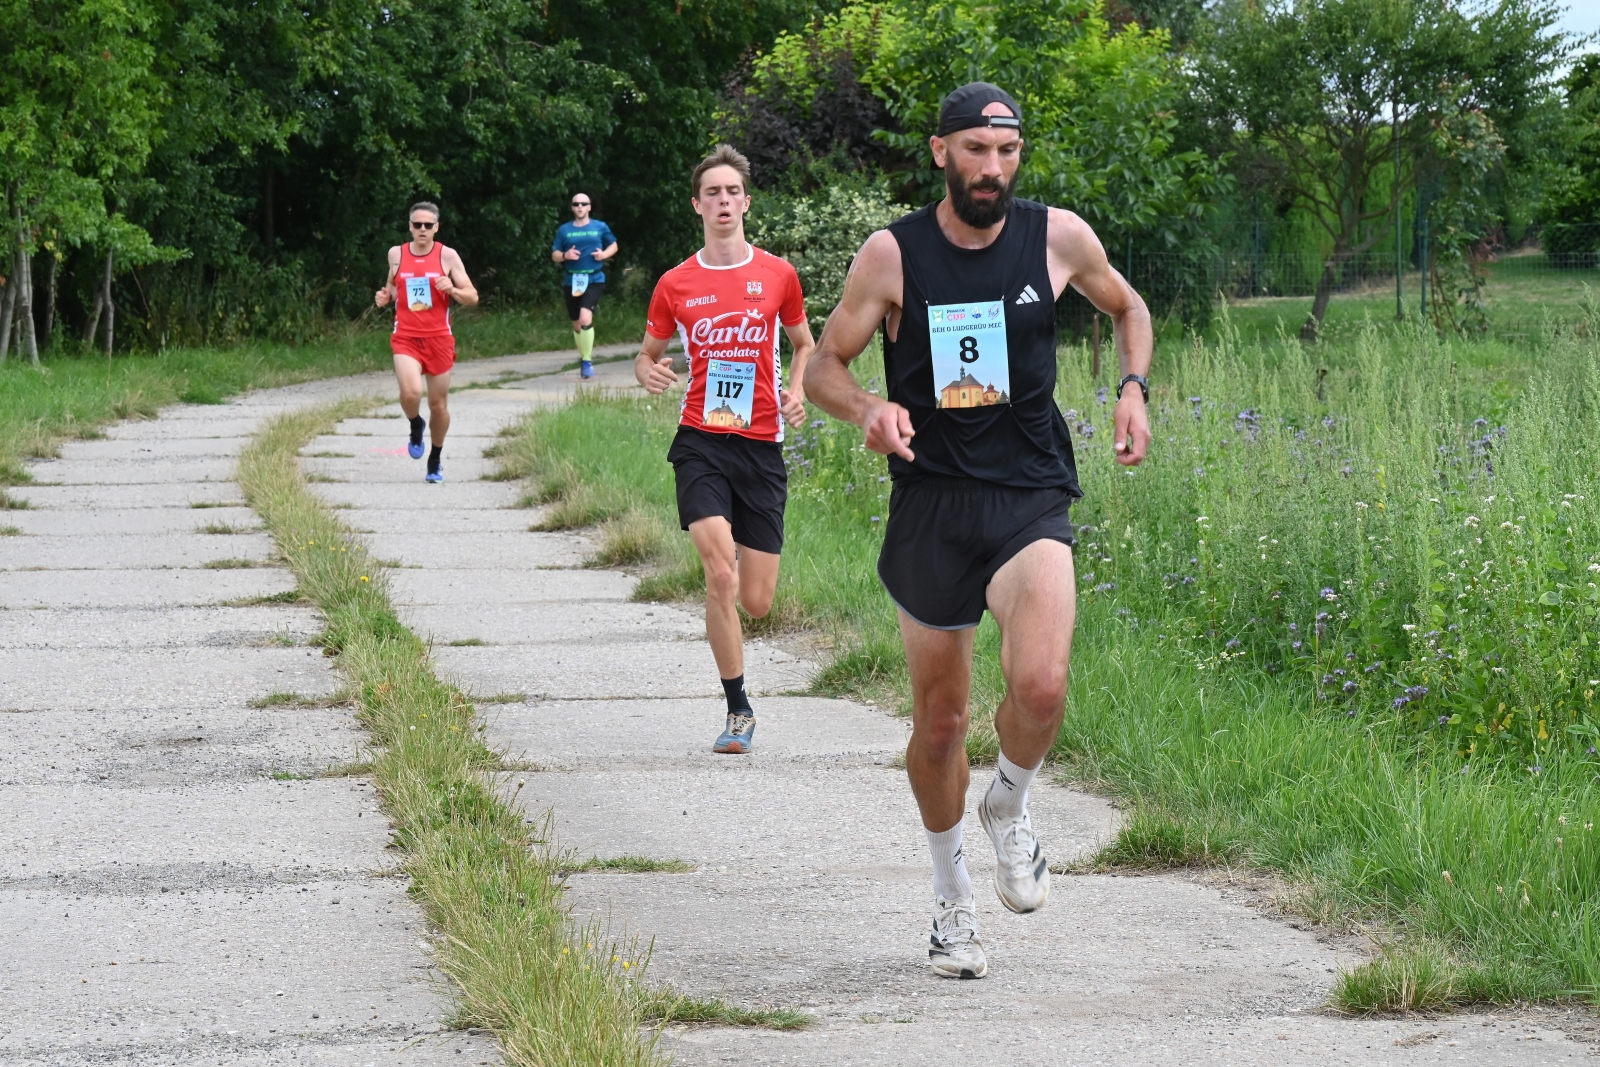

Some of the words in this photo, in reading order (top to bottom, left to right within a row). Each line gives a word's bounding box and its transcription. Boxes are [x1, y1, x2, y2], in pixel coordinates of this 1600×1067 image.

[413, 288, 424, 297] 72
[691, 315, 768, 346] Carla
[700, 347, 760, 358] Chocolates
[960, 336, 979, 363] 8
[716, 381, 744, 398] 117
